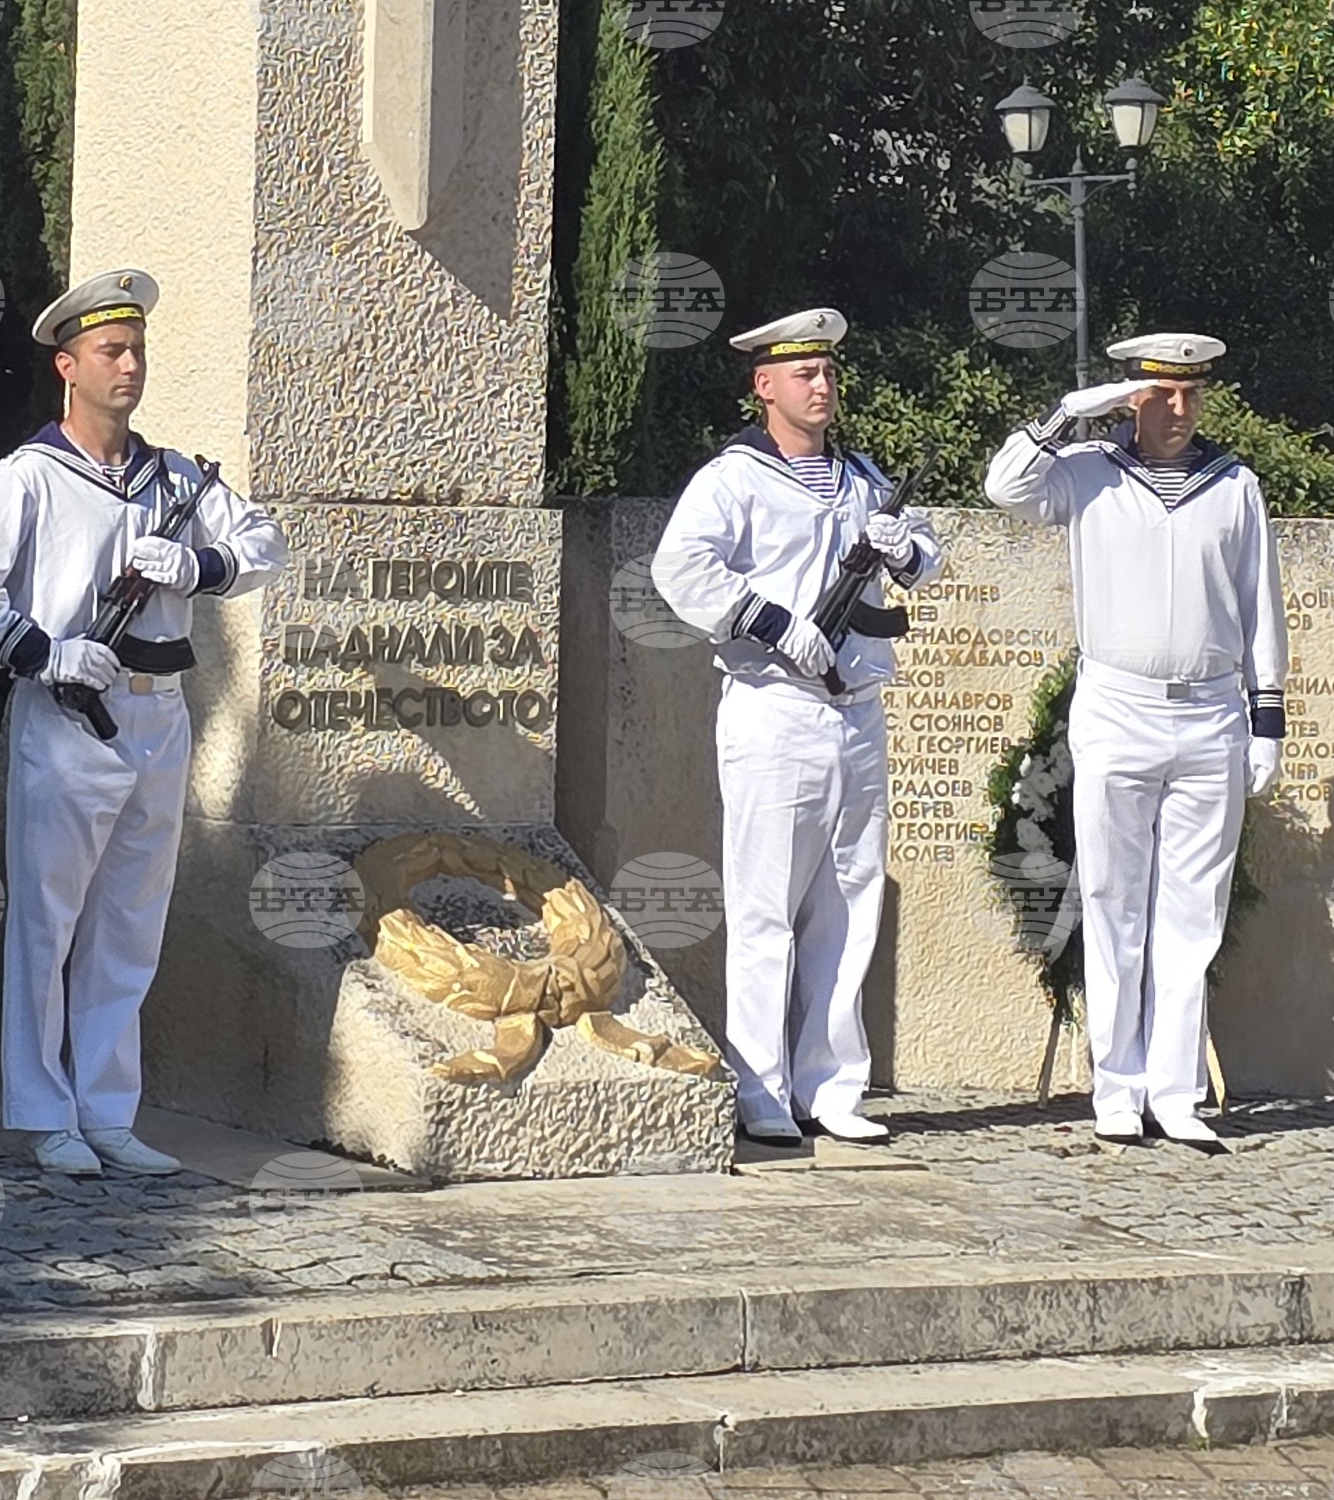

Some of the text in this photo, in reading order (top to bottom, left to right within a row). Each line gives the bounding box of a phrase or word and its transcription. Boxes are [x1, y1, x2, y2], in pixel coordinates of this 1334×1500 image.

[303, 558, 535, 601] НА ГЕРОИТЕ
[908, 584, 1001, 603] ГЕОРГИЕВ
[283, 623, 544, 667] ПАДНАЛИ ЗА
[912, 649, 1045, 667] МАЖАБАРОВ
[884, 670, 945, 688] ЕКОВ
[271, 687, 550, 732] ОТЕЧЕСТВОТО
[883, 692, 1014, 711] Я. КАНАВРОВ
[909, 714, 1005, 733] СТОЯНОВ
[893, 735, 1012, 754] К. ГЕОРГИЕВ
[892, 779, 973, 799] РАДОЕВ
[888, 800, 955, 821] ОБРЕВ
[890, 845, 955, 863] КОЛЕВ
